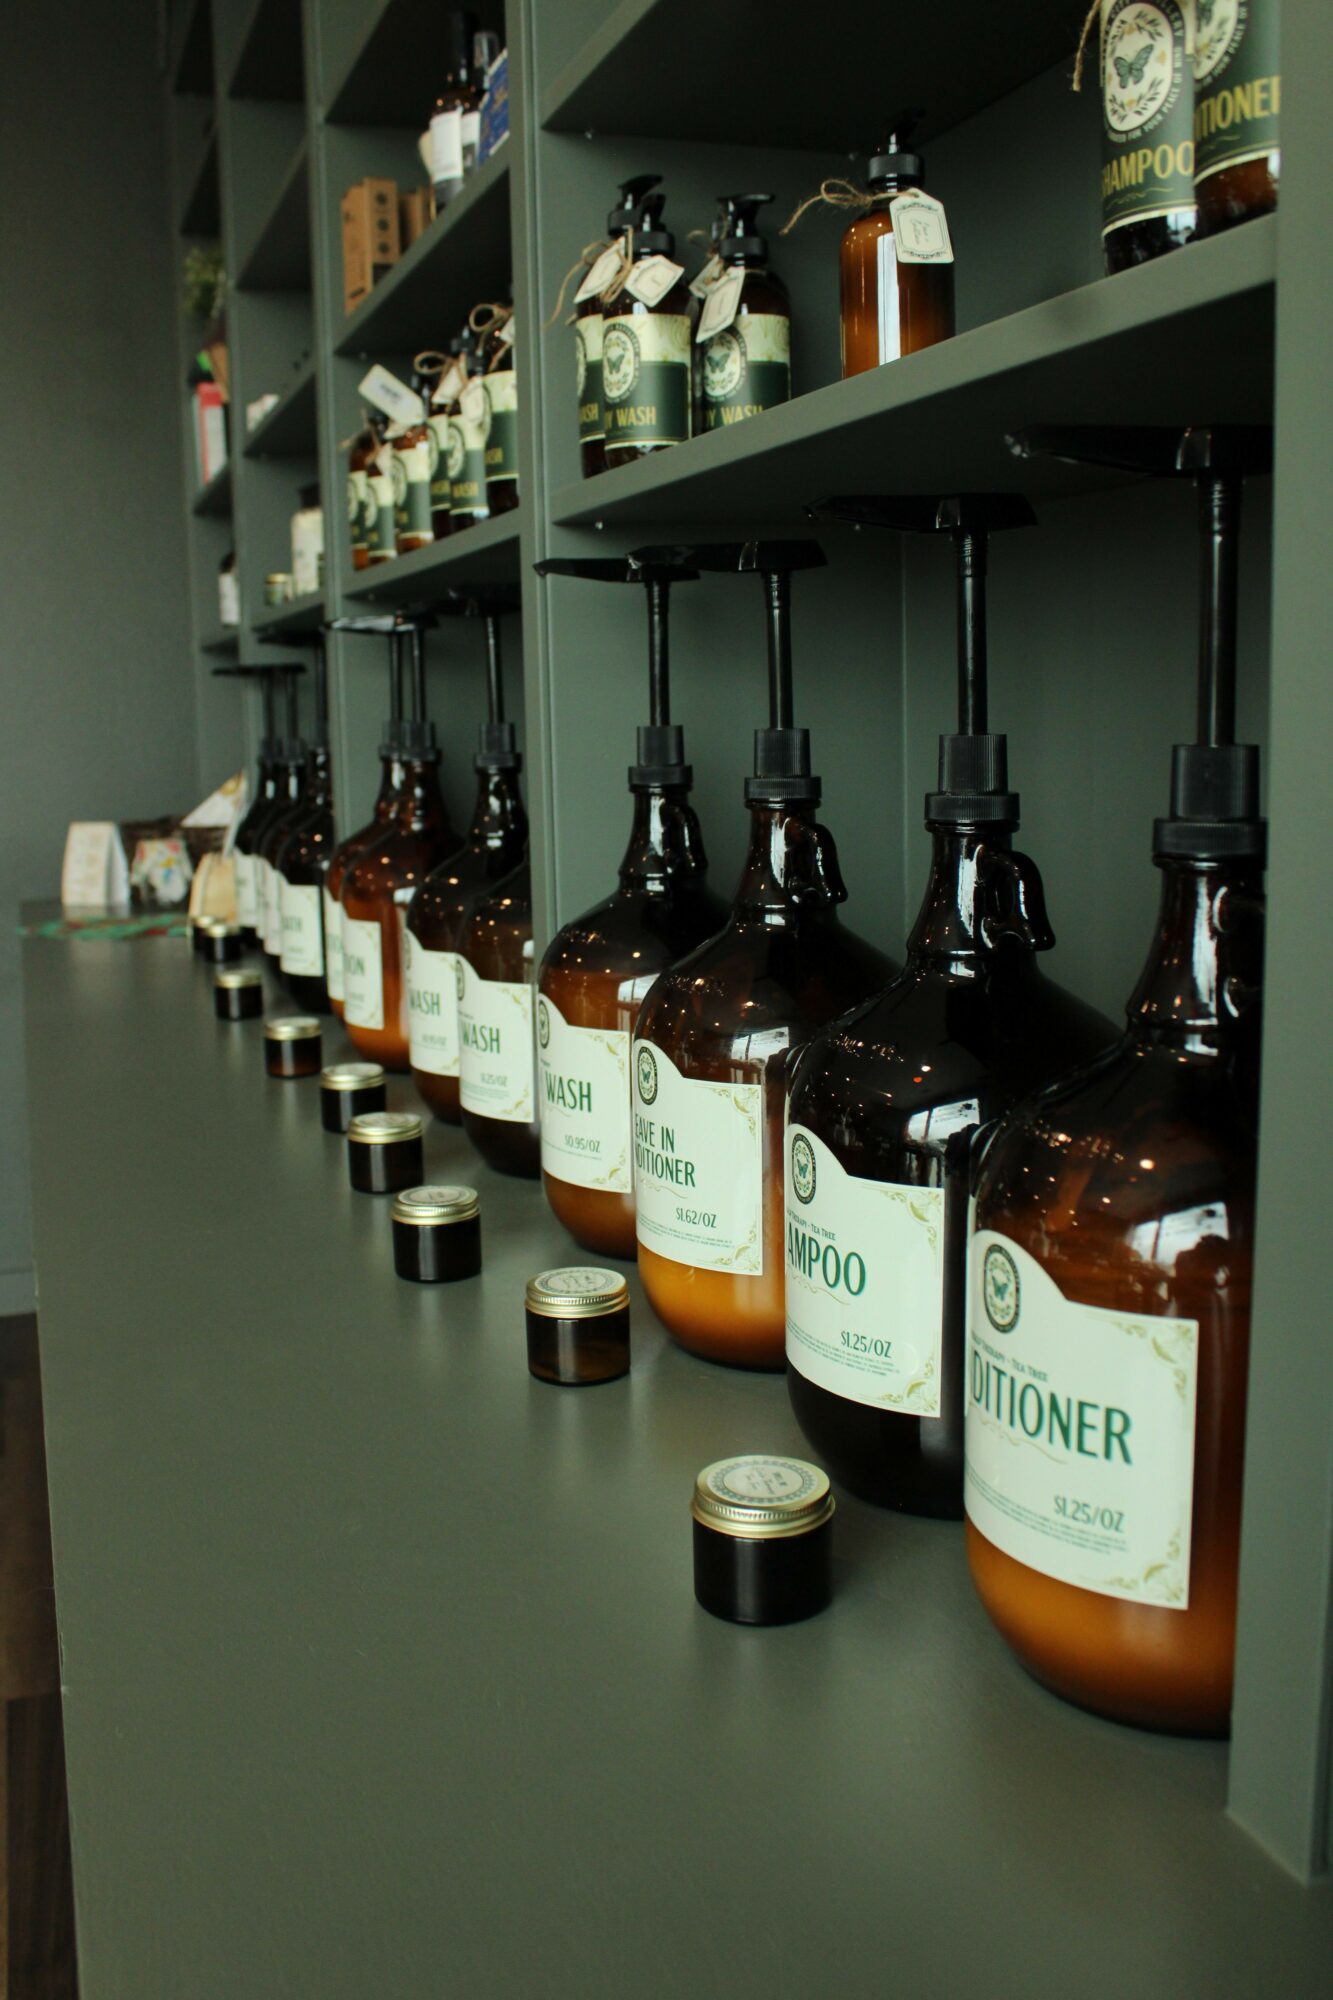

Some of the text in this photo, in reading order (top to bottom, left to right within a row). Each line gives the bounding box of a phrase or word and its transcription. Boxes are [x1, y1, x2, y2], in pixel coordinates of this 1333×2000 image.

[615, 405, 657, 427] WASH
[461, 1020, 501, 1054] WASH
[545, 1070, 592, 1113] WASH
[661, 1125, 675, 1154] IN
[821, 1227, 837, 1241] TREE
[841, 1331, 893, 1360] $1.25/OZ
[972, 1349, 1133, 1467] DITIONER
